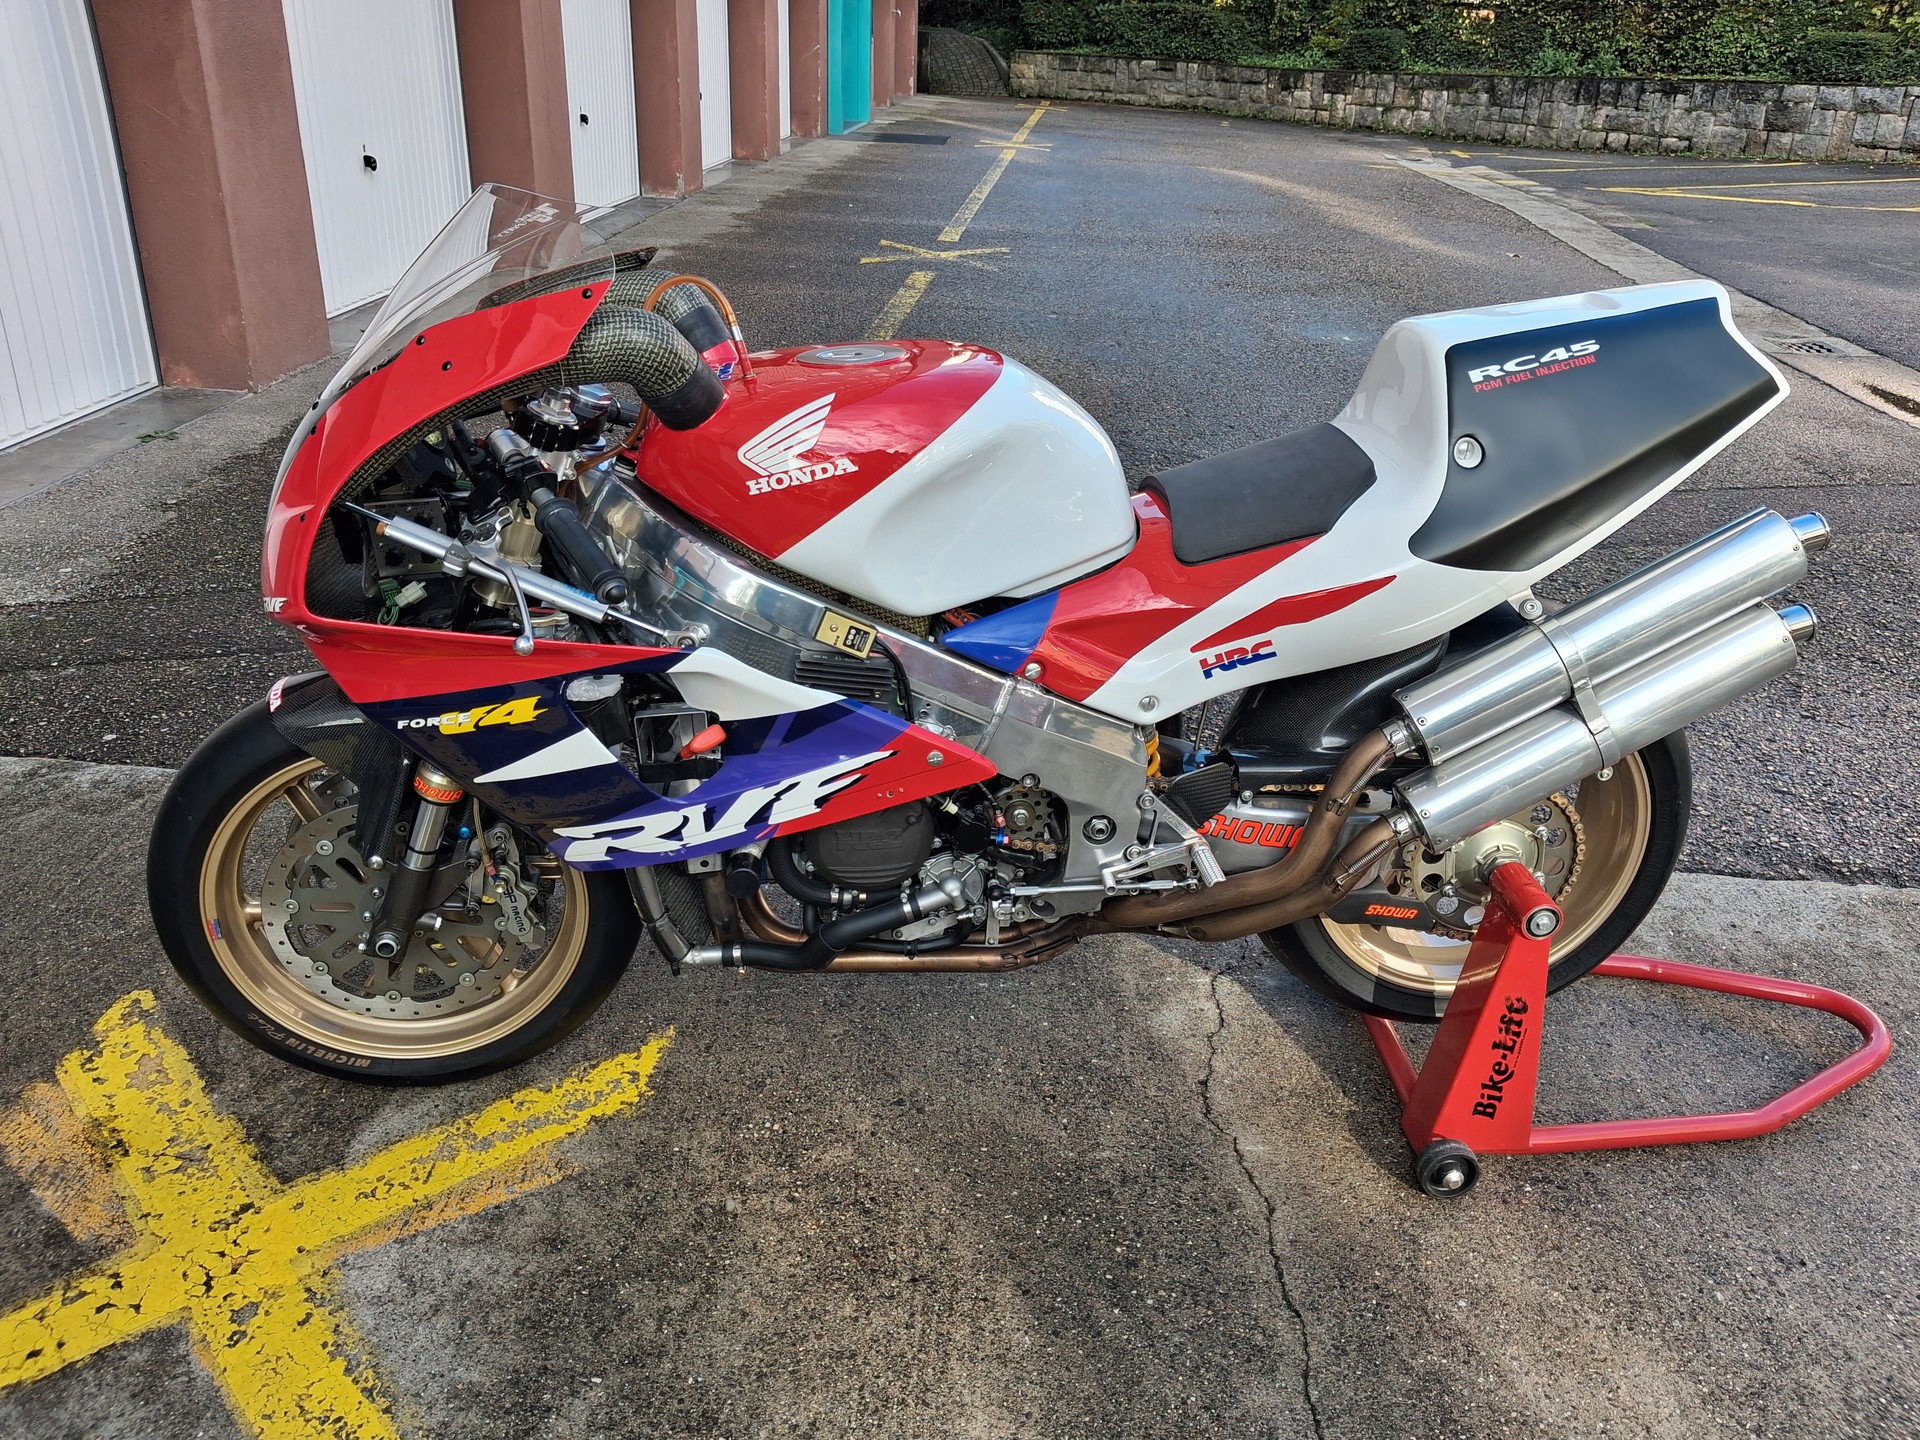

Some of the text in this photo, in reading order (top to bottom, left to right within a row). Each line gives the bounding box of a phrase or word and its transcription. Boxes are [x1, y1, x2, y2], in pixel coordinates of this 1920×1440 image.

[1468, 339, 1600, 384] RC45
[1473, 354, 1597, 393] PGM FUEL INJECTION
[746, 458, 859, 495] HONDA
[262, 597, 288, 613] RVF
[1199, 639, 1277, 679] HRC
[397, 711, 473, 729] FORCE
[413, 776, 464, 802] SHOWA
[553, 750, 893, 861] RVF
[510, 905, 527, 932] RACING
[1365, 904, 1418, 920] SHOWA
[247, 1012, 372, 1068] MICHELIN Pilot
[1472, 995, 1528, 1121] Bike-Lift
